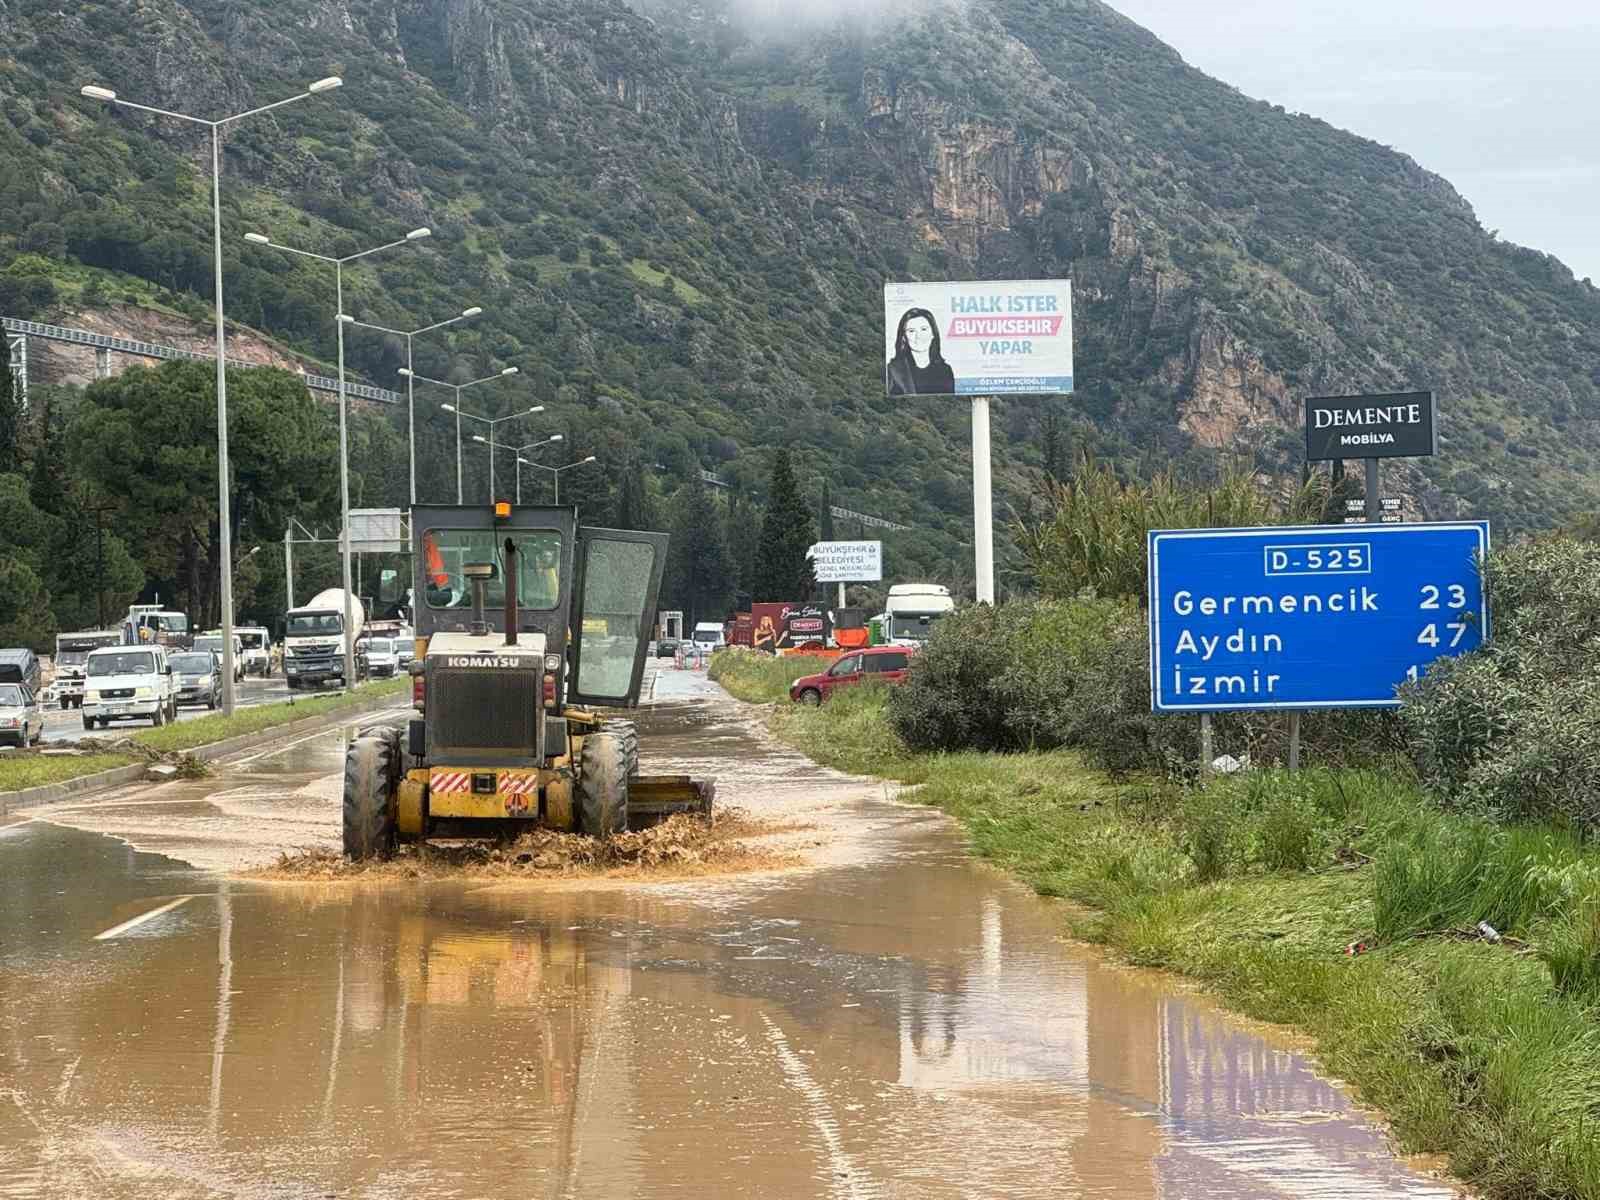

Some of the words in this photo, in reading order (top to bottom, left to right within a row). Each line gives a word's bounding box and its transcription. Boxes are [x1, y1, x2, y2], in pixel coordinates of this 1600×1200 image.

[951, 295, 1002, 313] HALK
[1008, 294, 1058, 312] İSTER
[979, 340, 1033, 355] YAPAR
[1313, 403, 1421, 429] DEMENTE
[1340, 431, 1395, 446] MOBİLYA
[1271, 548, 1364, 571] D-525
[1173, 586, 1379, 616] Germencik
[1419, 584, 1467, 610] 23
[1175, 627, 1283, 661] Aydın
[1417, 623, 1467, 648] 47
[448, 656, 520, 668] KOMATSU
[1174, 664, 1281, 695] İzmir
